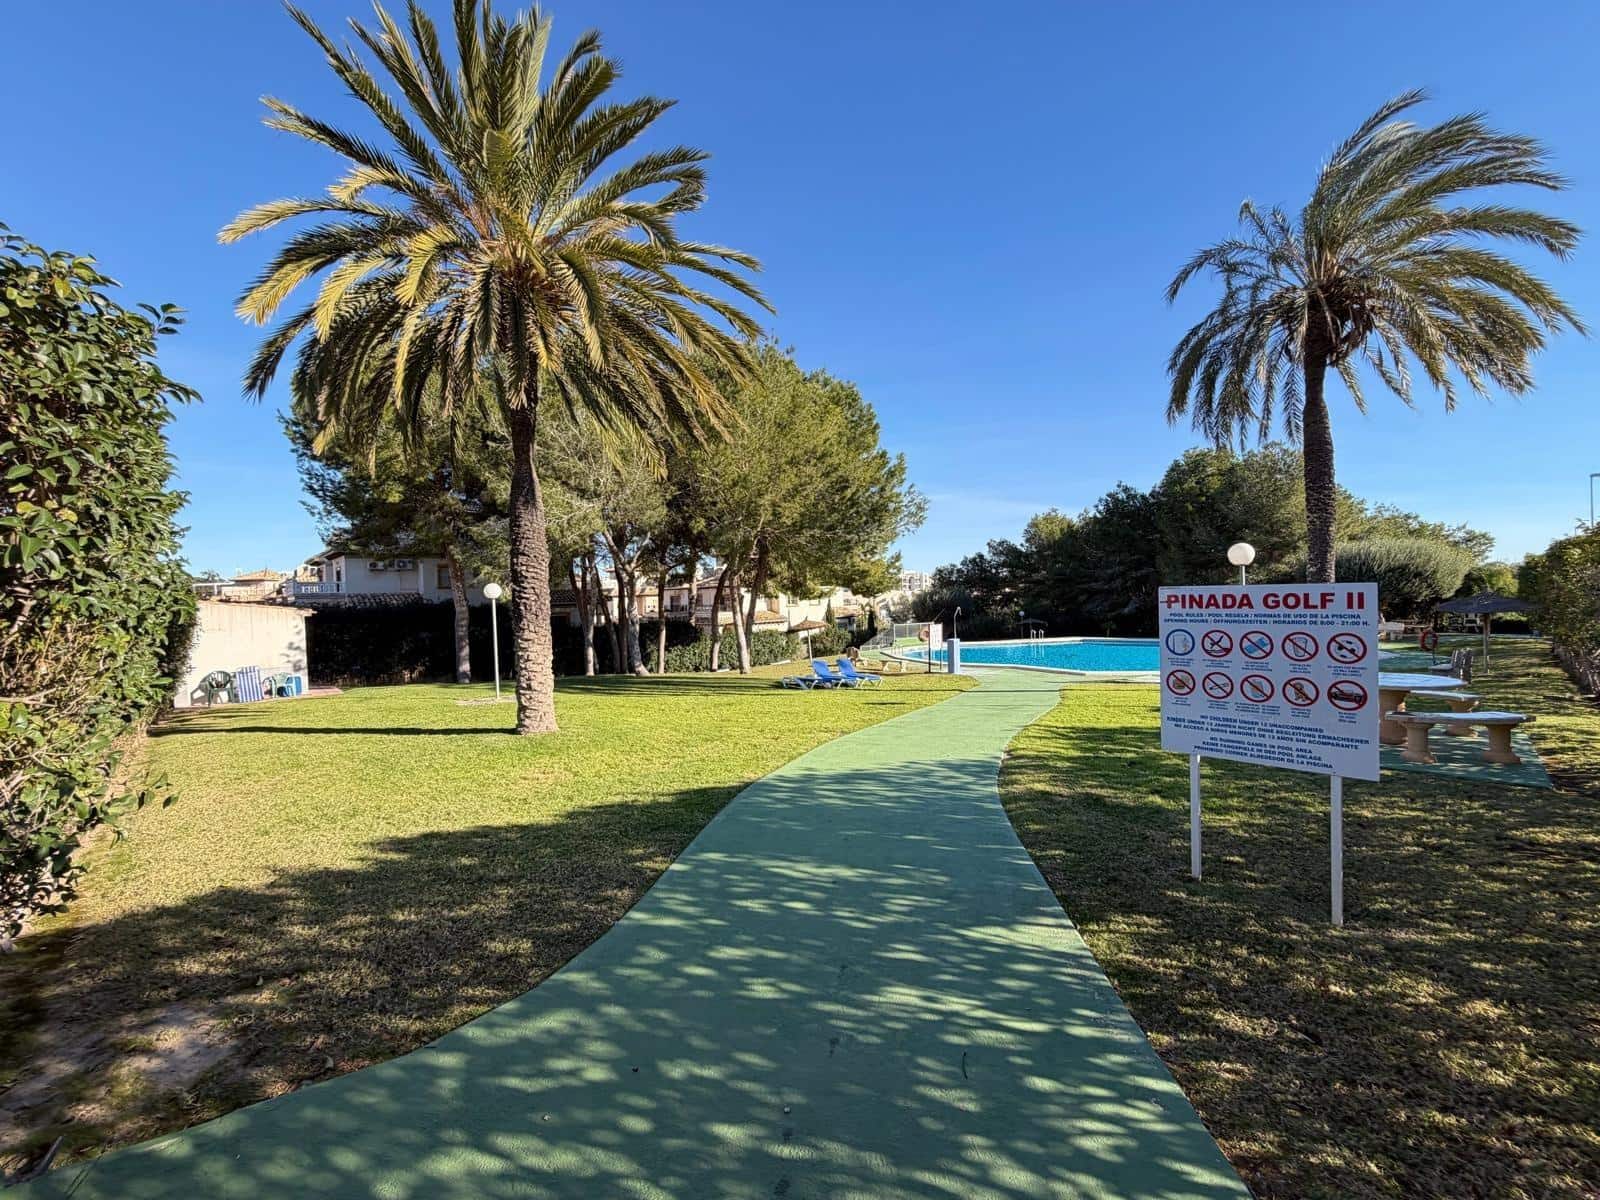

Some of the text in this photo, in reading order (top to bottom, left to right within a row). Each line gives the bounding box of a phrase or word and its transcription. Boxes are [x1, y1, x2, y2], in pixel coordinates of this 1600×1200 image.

[1167, 592, 1364, 609] PINADA GOLF II
